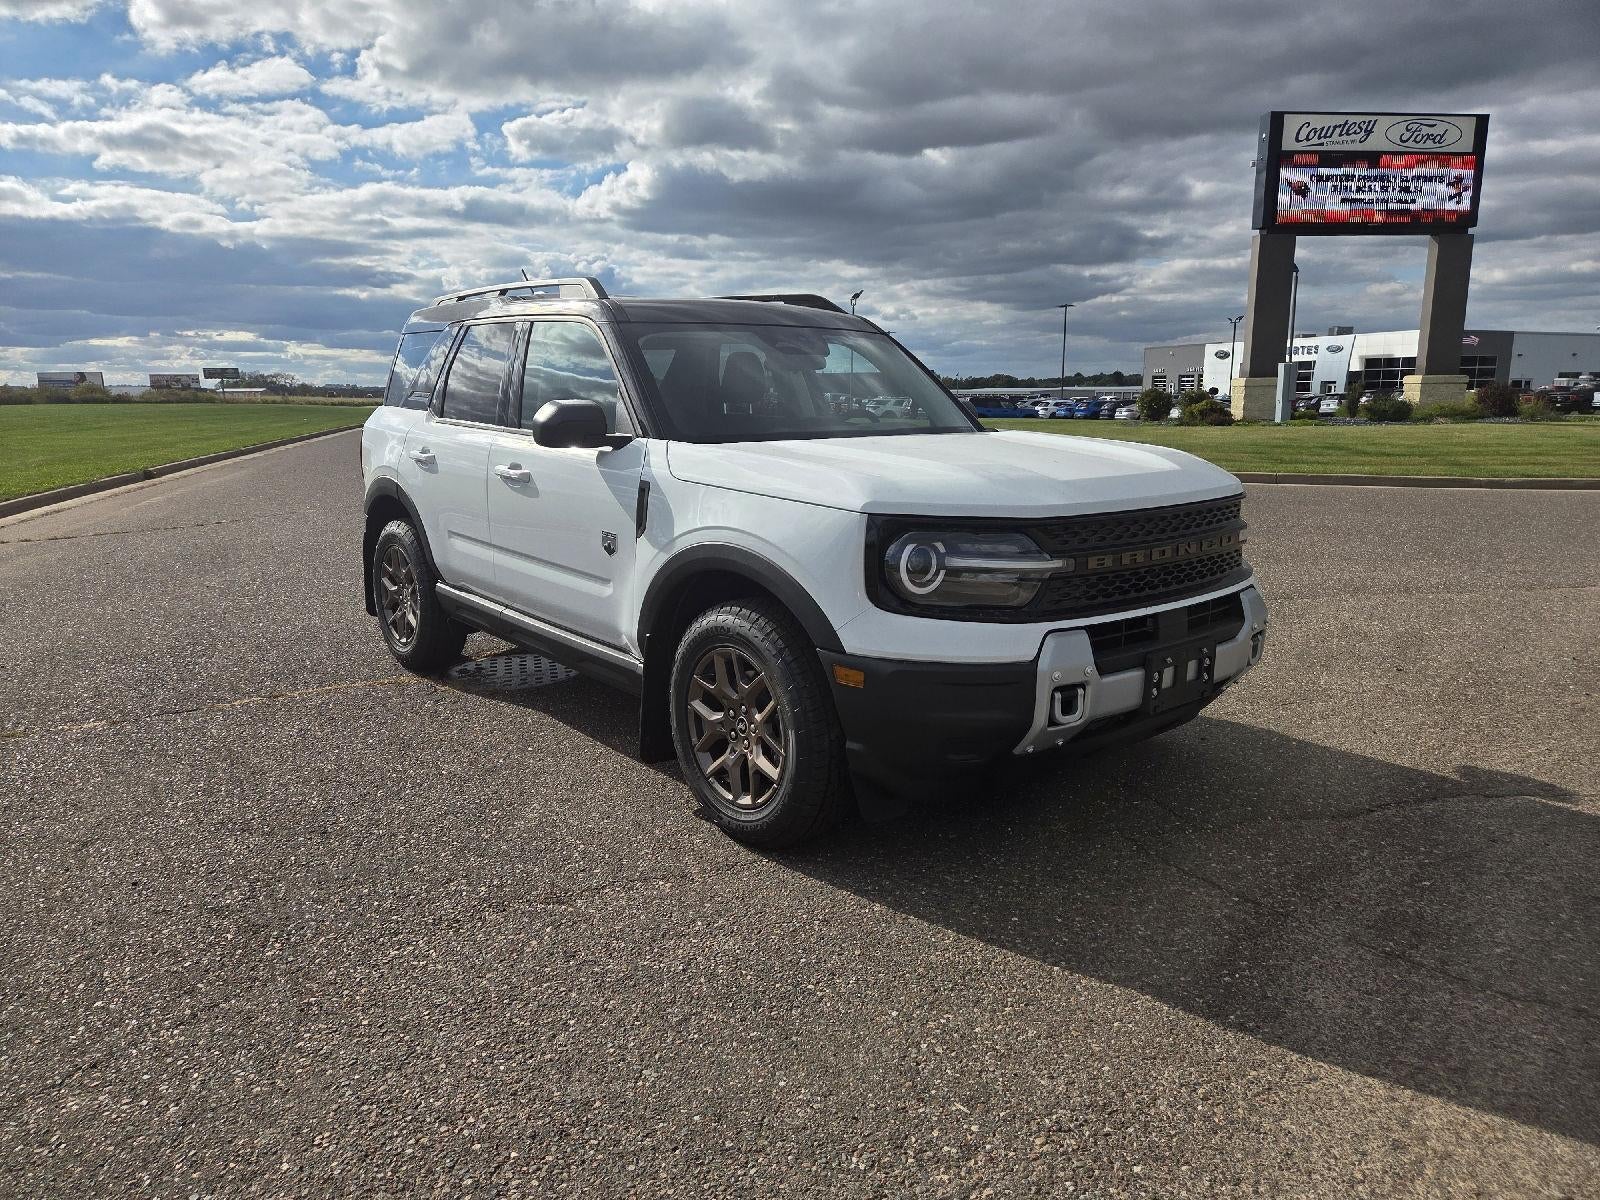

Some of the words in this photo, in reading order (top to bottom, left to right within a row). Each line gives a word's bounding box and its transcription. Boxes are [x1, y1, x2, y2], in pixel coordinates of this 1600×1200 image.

[1295, 119, 1378, 143] Courtesy
[1399, 122, 1449, 144] Ford
[1087, 535, 1237, 570] BRONCO
